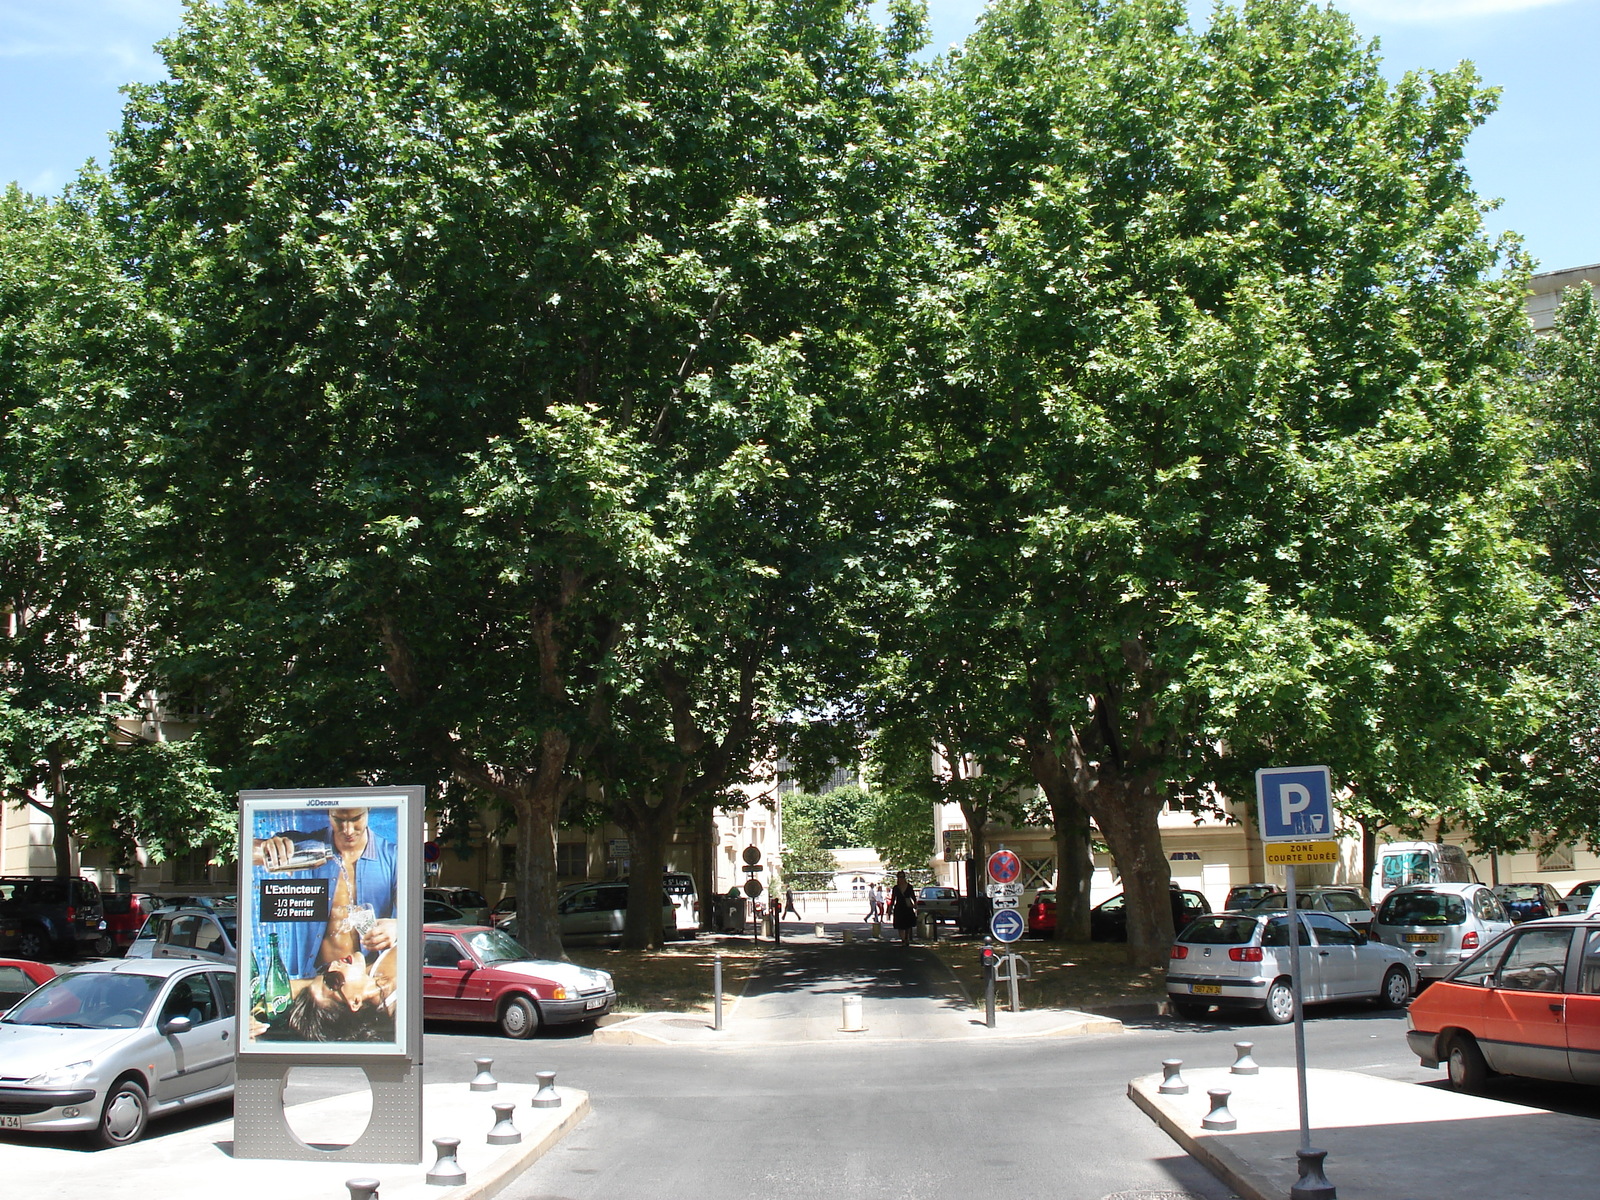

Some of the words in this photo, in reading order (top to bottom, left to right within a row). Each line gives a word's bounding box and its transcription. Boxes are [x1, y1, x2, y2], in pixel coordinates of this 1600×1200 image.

[306, 799, 340, 807] JCDecaux
[1279, 783, 1310, 826] P
[1290, 844, 1314, 852] ZONE
[1268, 854, 1303, 862] COURTE
[1306, 852, 1337, 861] DURÉE
[274, 898, 289, 907] -1/3
[289, 898, 315, 907] Perrier
[273, 908, 289, 918] -2/3
[289, 908, 315, 917] Perrier
[7, 1116, 18, 1127] 34
